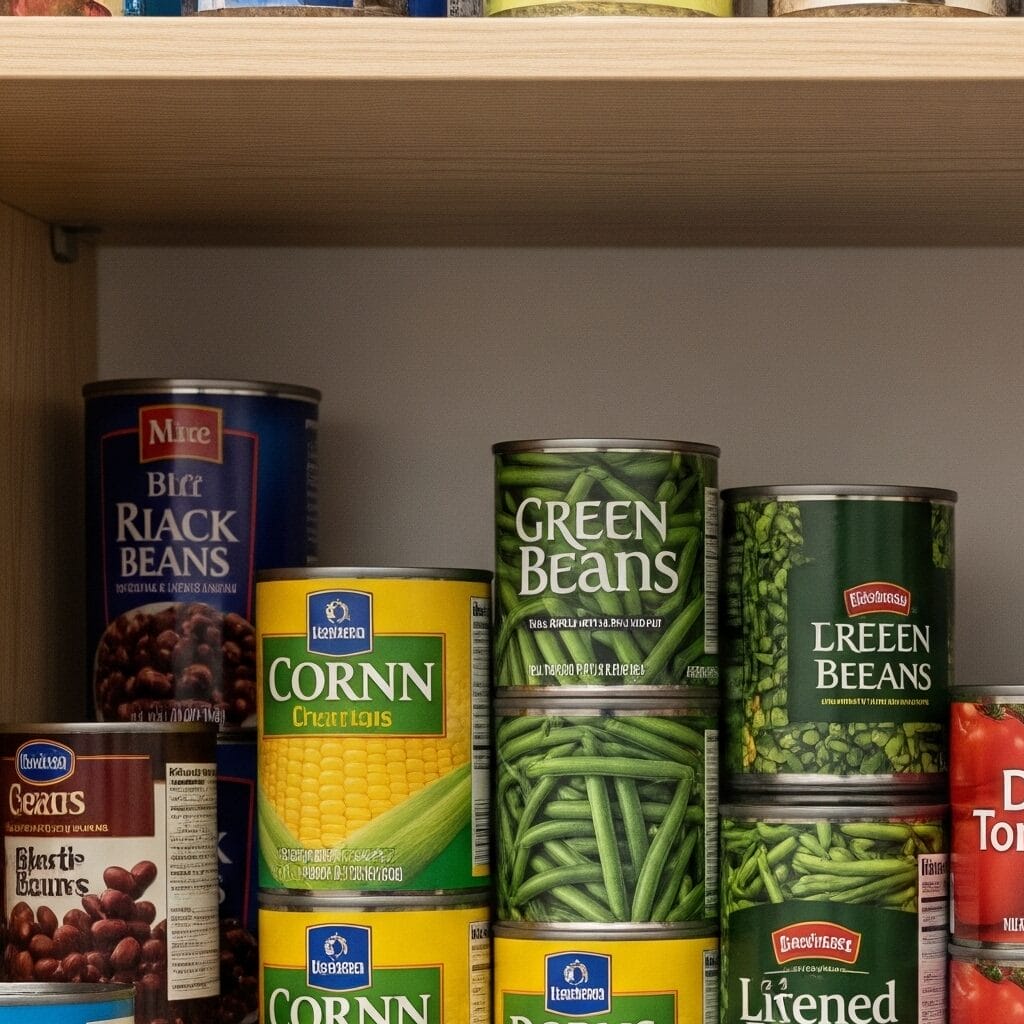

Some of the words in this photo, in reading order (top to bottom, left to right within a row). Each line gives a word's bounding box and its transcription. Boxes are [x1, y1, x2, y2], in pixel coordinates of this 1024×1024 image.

[516, 497, 667, 550] GREEN
[120, 546, 230, 577] BEANS
[269, 657, 436, 702] CORNN
